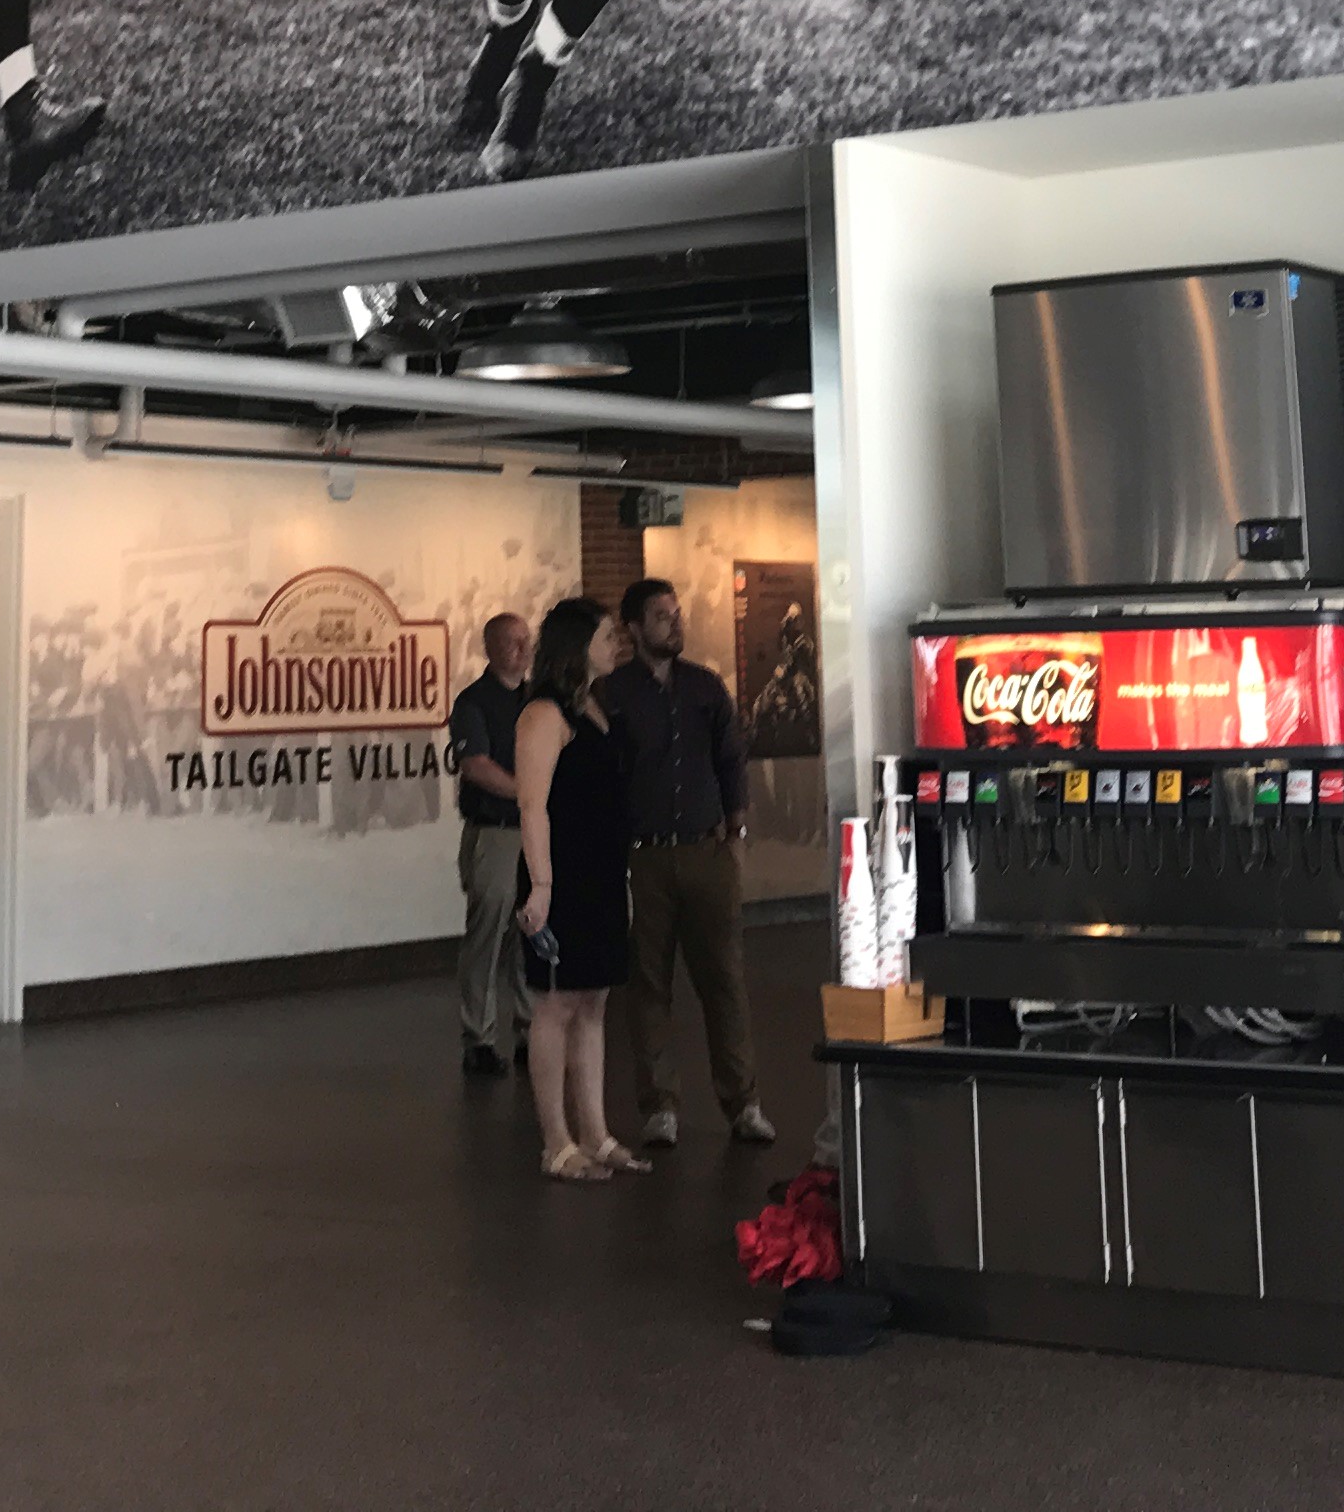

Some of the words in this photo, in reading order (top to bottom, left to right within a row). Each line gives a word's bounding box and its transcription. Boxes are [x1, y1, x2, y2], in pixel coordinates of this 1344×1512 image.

[214, 633, 439, 722] Johnsonville
[963, 658, 1098, 726] Coca-Cola
[166, 744, 333, 791] TAILGATE
[348, 740, 460, 783] VILLAG
